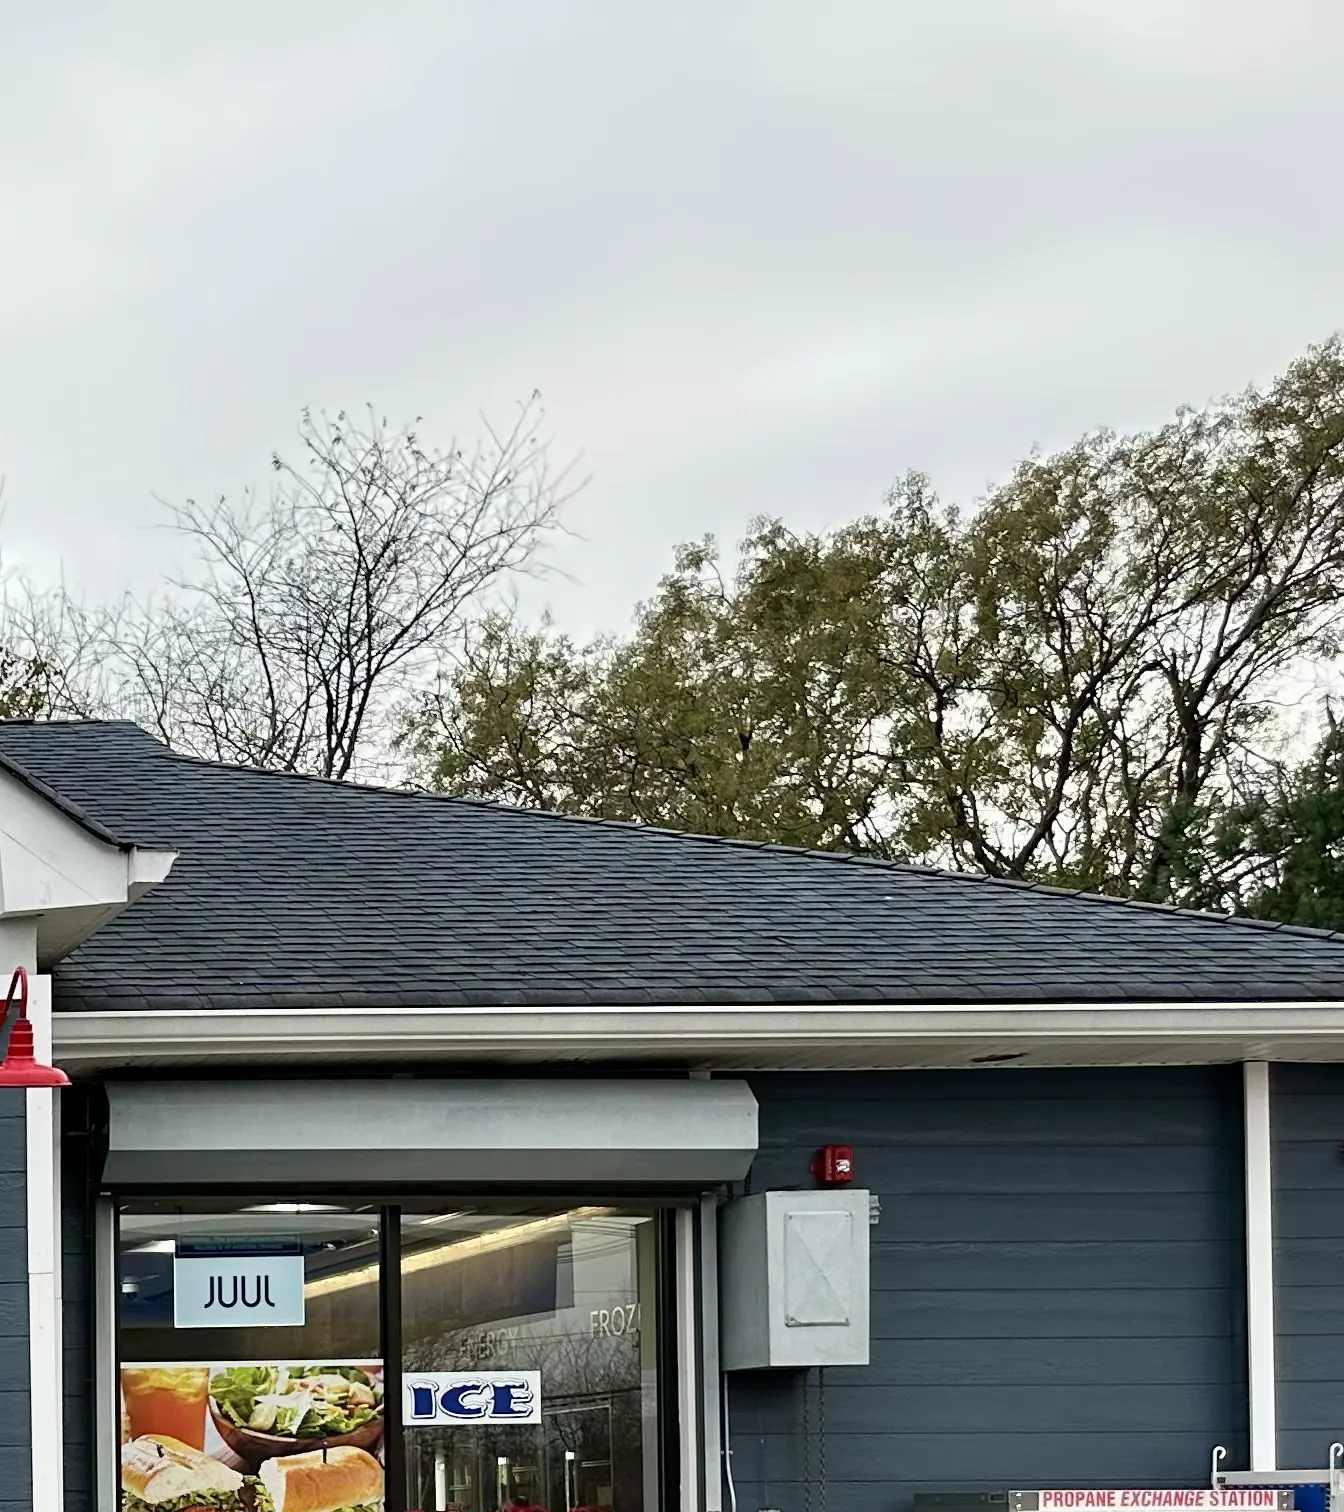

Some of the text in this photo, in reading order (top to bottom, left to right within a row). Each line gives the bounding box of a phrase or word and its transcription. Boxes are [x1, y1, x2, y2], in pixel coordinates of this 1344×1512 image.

[204, 1275, 275, 1308] JUUL
[407, 1378, 533, 1419] ICE
[1043, 1490, 1274, 1507] PROPANE EXCHANGE STATION
